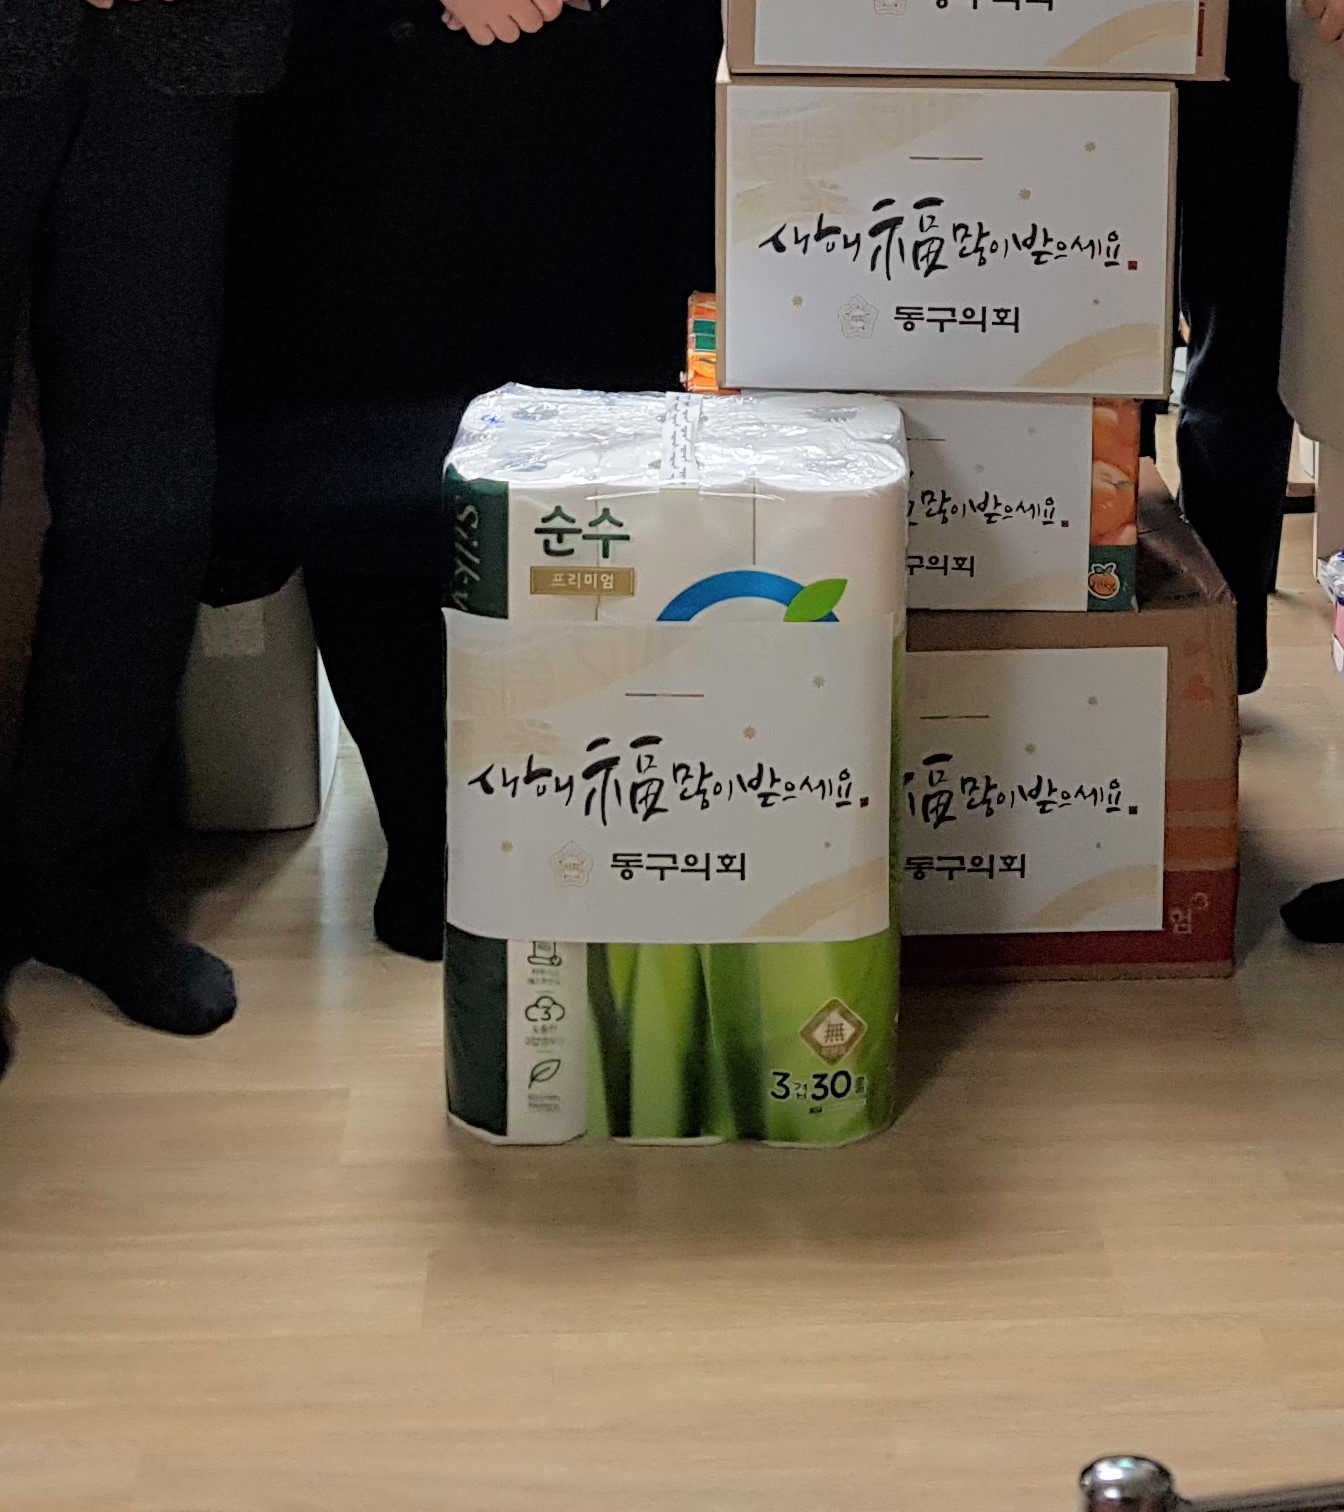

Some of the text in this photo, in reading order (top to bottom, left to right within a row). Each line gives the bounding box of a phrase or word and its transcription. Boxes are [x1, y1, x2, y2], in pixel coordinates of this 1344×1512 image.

[758, 212, 862, 263] 새해
[868, 197, 948, 280] 福
[952, 220, 1009, 267] 많이
[893, 305, 1021, 334] 동구의회
[920, 489, 967, 524] 많이
[534, 504, 631, 560] 순수
[550, 572, 616, 590] 프리미엄
[906, 554, 976, 578] 구의회
[467, 754, 575, 807] 새해
[581, 735, 669, 827] 福
[671, 760, 733, 811] 많이
[960, 774, 1015, 818] 많이
[610, 851, 747, 882] 동구의회
[904, 853, 1027, 881] 동구의회
